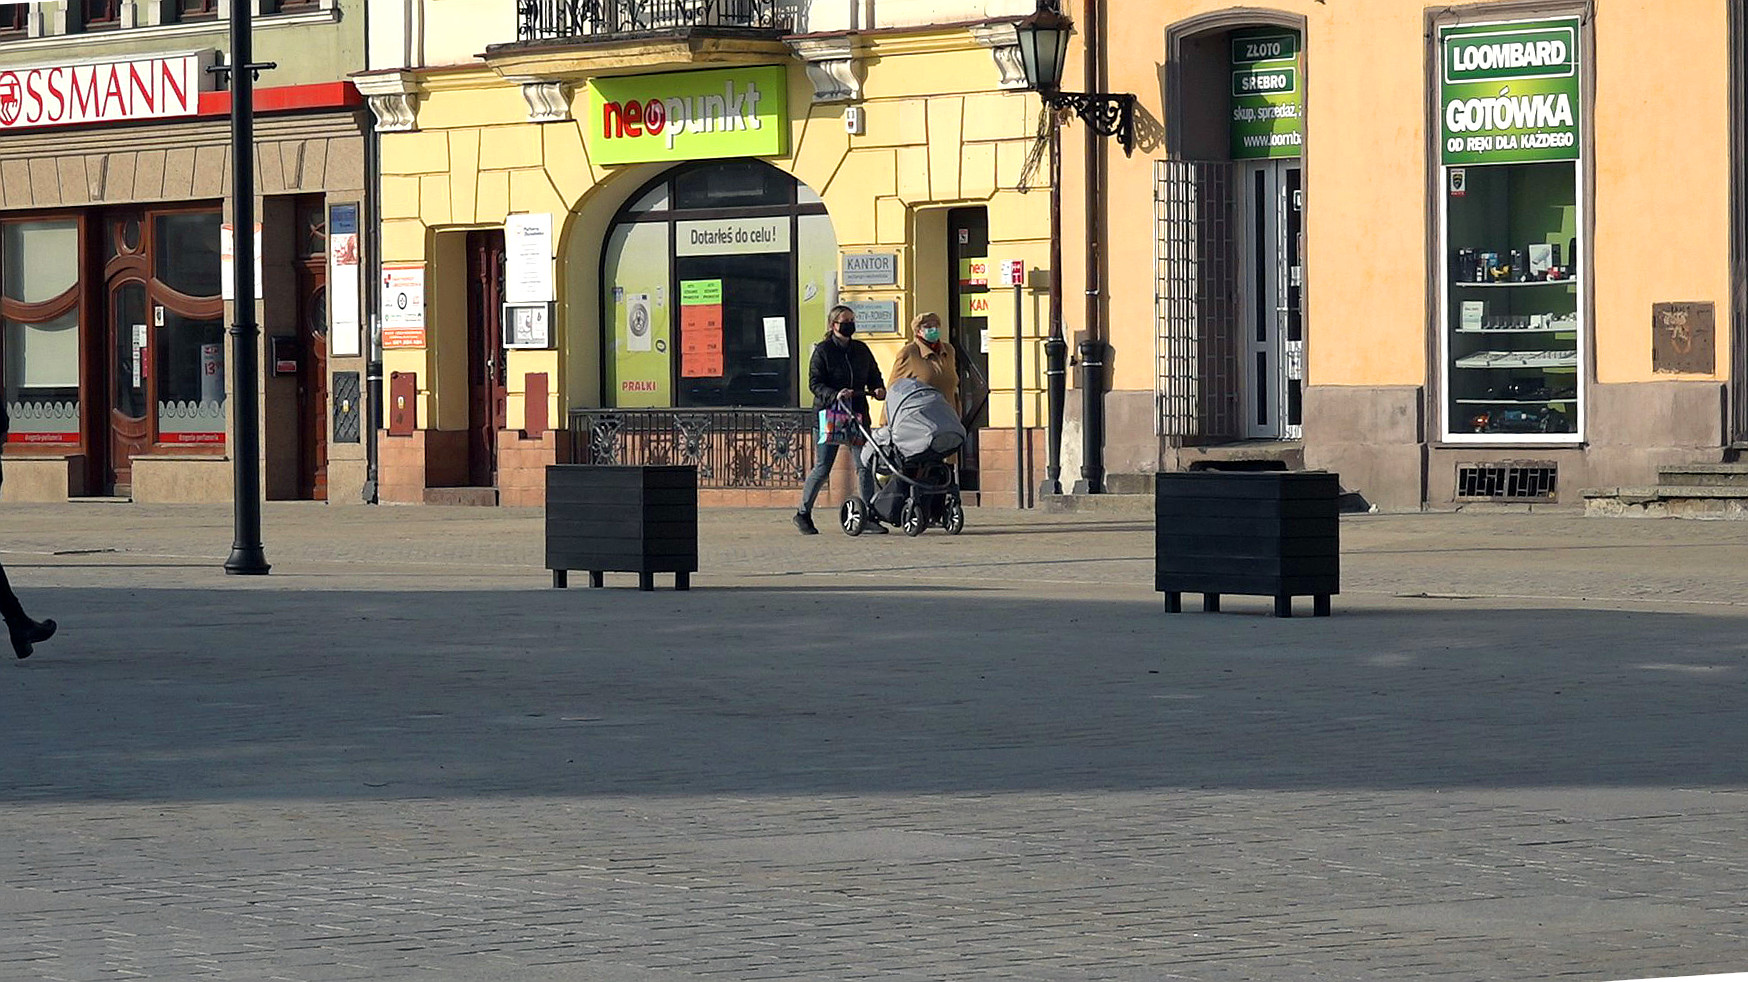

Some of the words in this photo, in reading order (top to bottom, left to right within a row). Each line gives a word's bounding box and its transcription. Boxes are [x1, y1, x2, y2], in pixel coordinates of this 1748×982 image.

[1246, 42, 1280, 57] ZŁOTO
[1453, 40, 1566, 71] LOOMBARD
[1242, 75, 1287, 90] SREBRO
[602, 80, 761, 150] neopunkt
[1233, 106, 1256, 122] skup,
[1258, 103, 1297, 121] sprzedaż,
[1446, 86, 1574, 132] GOTÓWKA
[1447, 138, 1464, 152] OD
[1467, 136, 1493, 154] RĘKI
[1496, 135, 1518, 149] DLA
[1521, 130, 1574, 149] KAŻDEGO
[691, 227, 732, 244] Dotarłeś
[735, 228, 747, 243] do
[847, 257, 889, 270] KANTOR
[622, 381, 656, 391] PRALKI
